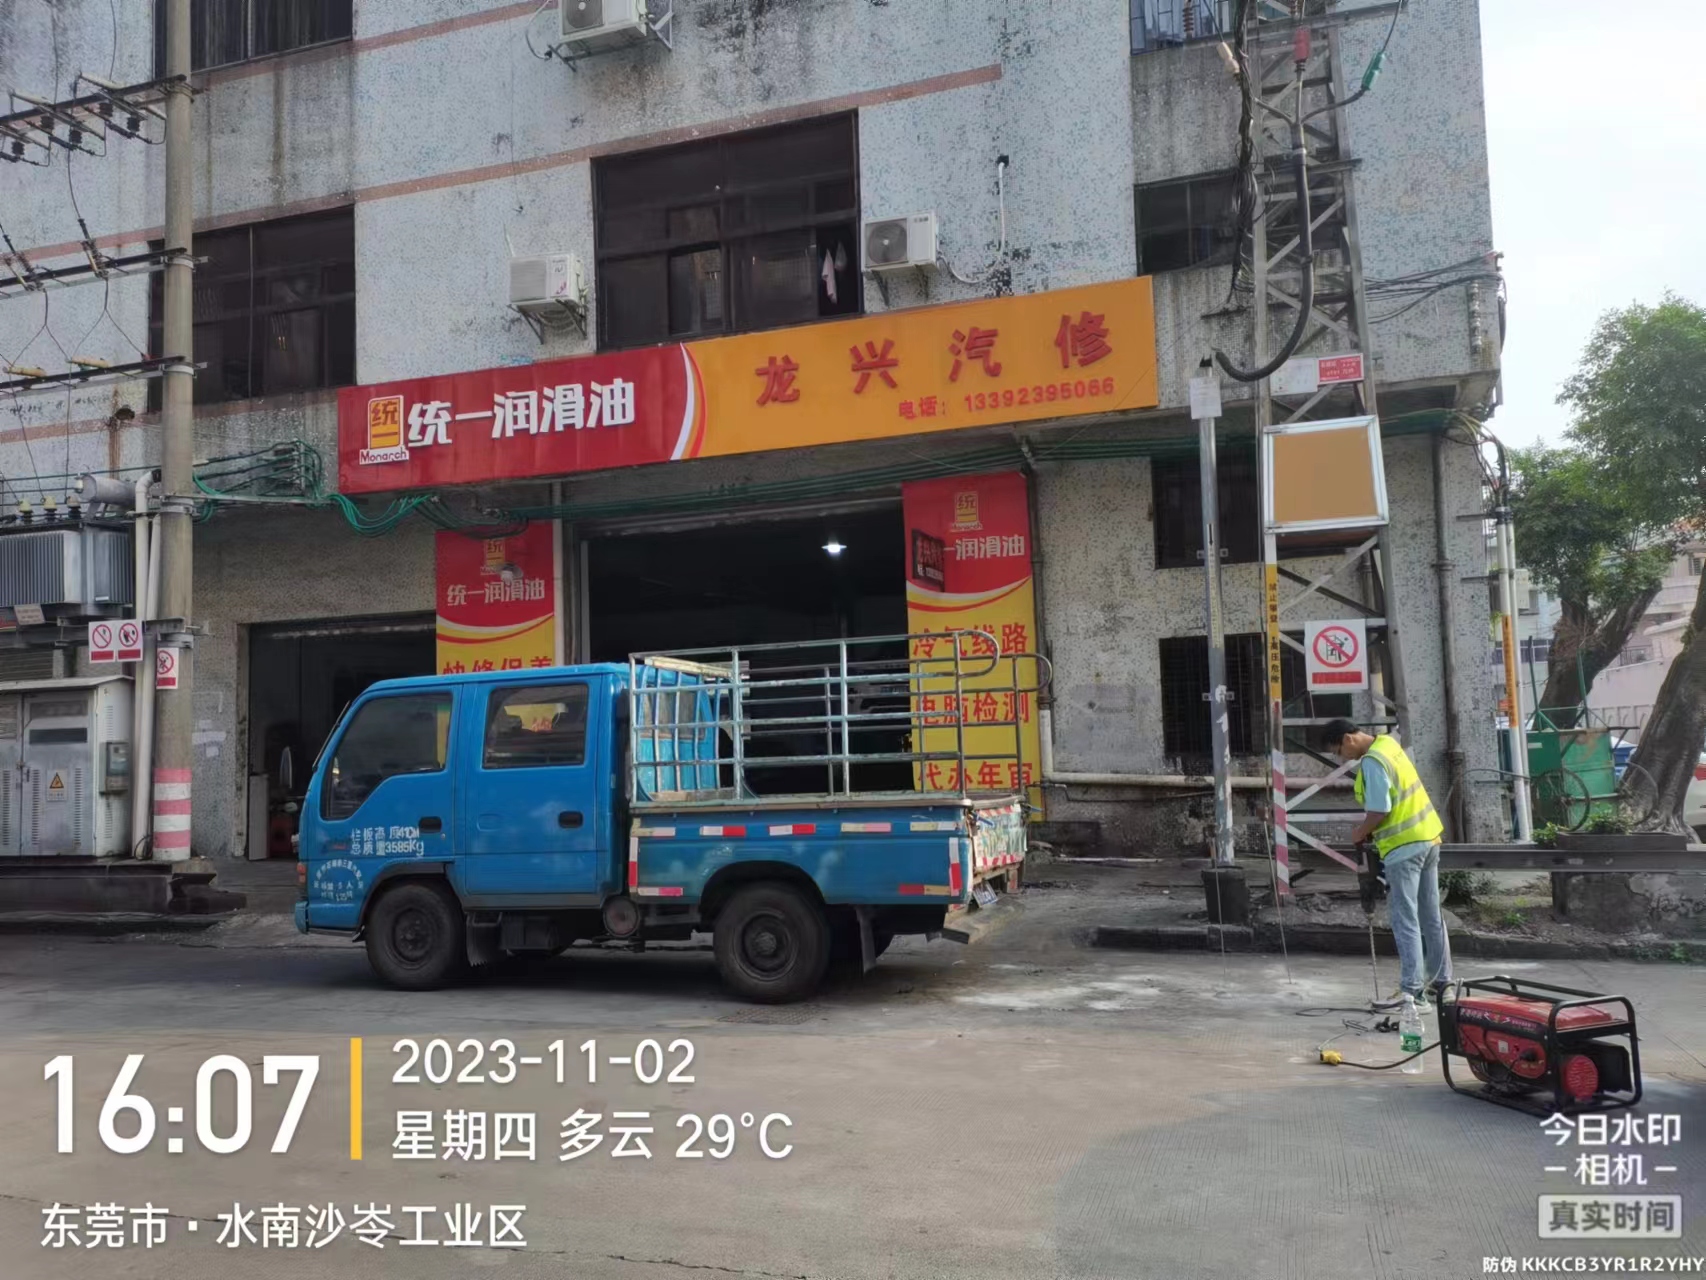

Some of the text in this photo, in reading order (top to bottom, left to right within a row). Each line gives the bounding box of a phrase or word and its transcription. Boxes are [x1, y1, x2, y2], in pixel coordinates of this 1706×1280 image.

[756, 311, 1113, 407] 龙兴汽修
[407, 378, 636, 447] 统一润滑油
[360, 446, 407, 464] Monarch
[447, 578, 545, 606] 统一润滑油
[912, 622, 1028, 658] 冷气线路
[915, 691, 1030, 724] 电脑检测
